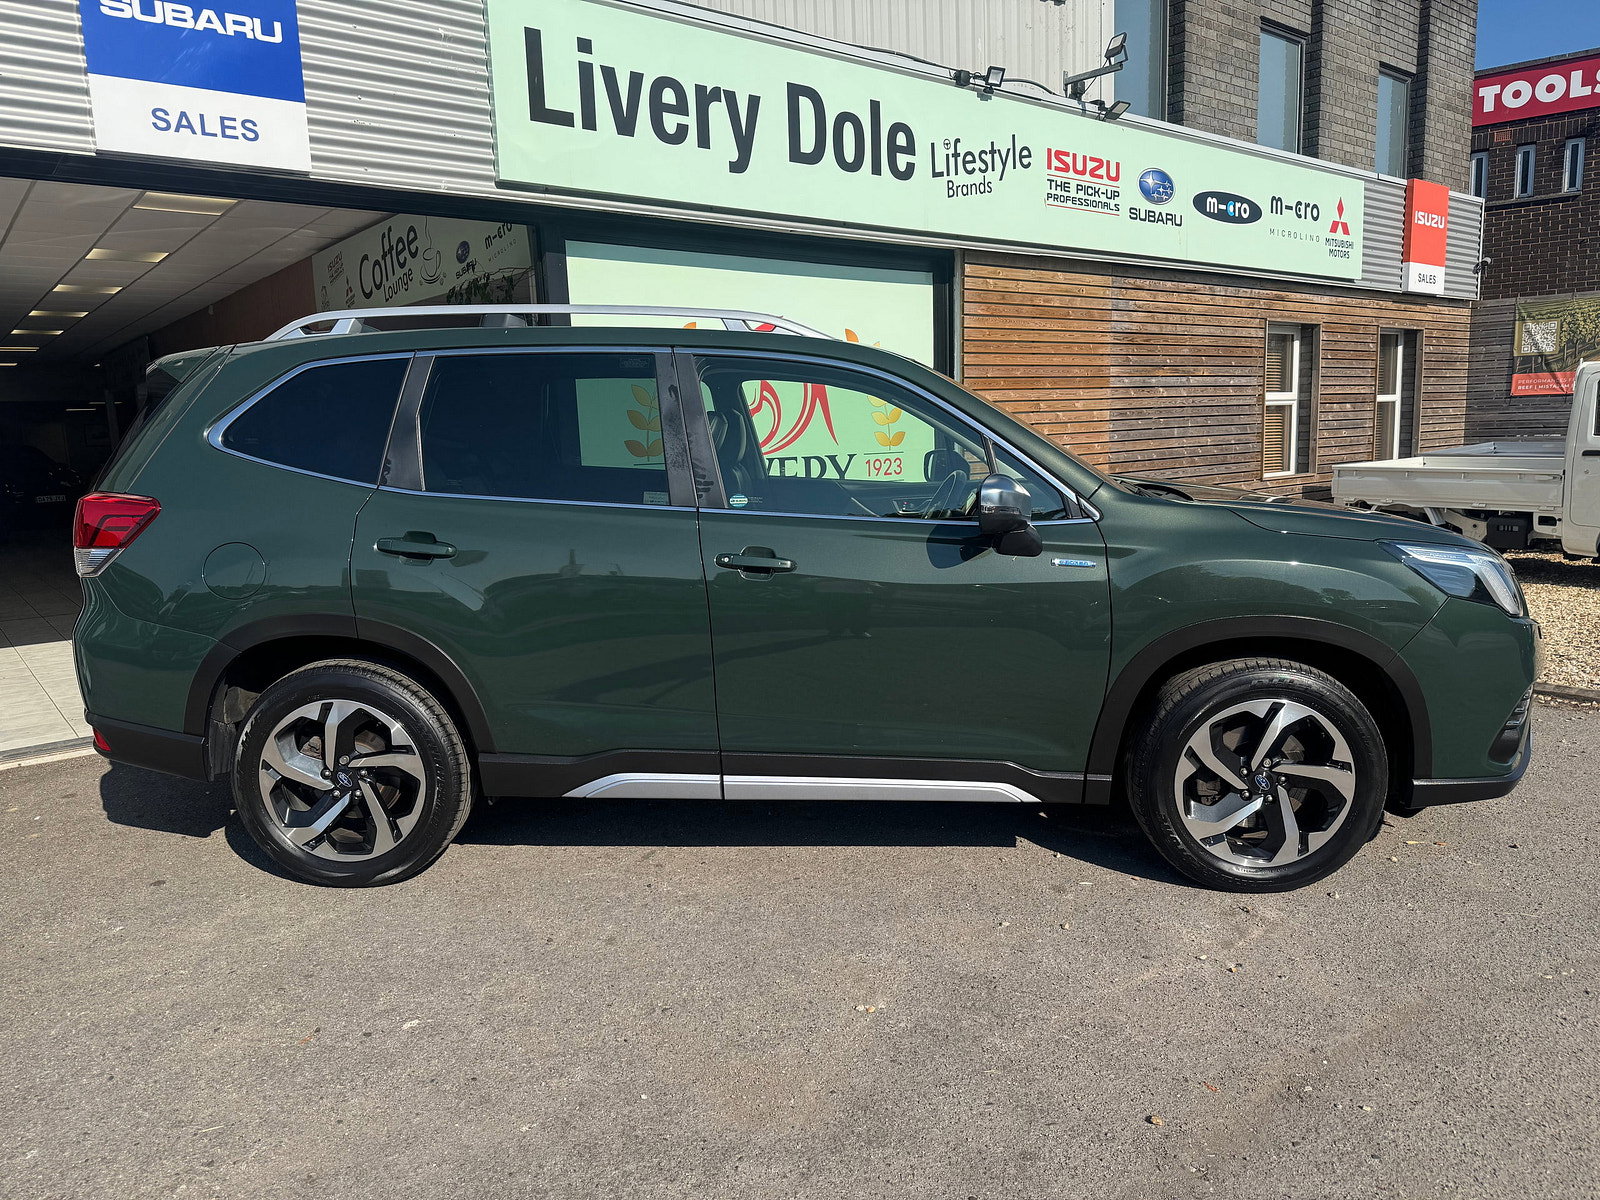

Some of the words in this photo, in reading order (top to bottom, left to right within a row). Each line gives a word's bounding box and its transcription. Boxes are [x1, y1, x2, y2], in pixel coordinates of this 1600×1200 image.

[100, 0, 283, 44] SUBARU
[1478, 69, 1600, 113] TOOL
[523, 26, 761, 174] Livery
[786, 81, 917, 181] Dole
[151, 107, 260, 142] SALES
[930, 134, 1033, 181] Lifestyle
[1046, 147, 1121, 183] ISUZU
[946, 175, 993, 198] Brands
[1046, 178, 1071, 194] THE
[1075, 183, 1121, 201] PICK-UP
[1046, 192, 1121, 212] PROFESSIONALS
[1128, 206, 1183, 227] SUBARU
[1414, 210, 1445, 229] ISUZU
[1269, 227, 1320, 243] MICROLINO
[1325, 237, 1355, 249] MITSUBISHI
[359, 225, 419, 299] Coffee
[1328, 248, 1350, 259] MOTORS
[383, 268, 414, 302] Lounge
[1417, 272, 1437, 285] SALES
[865, 457, 903, 477] 1923
